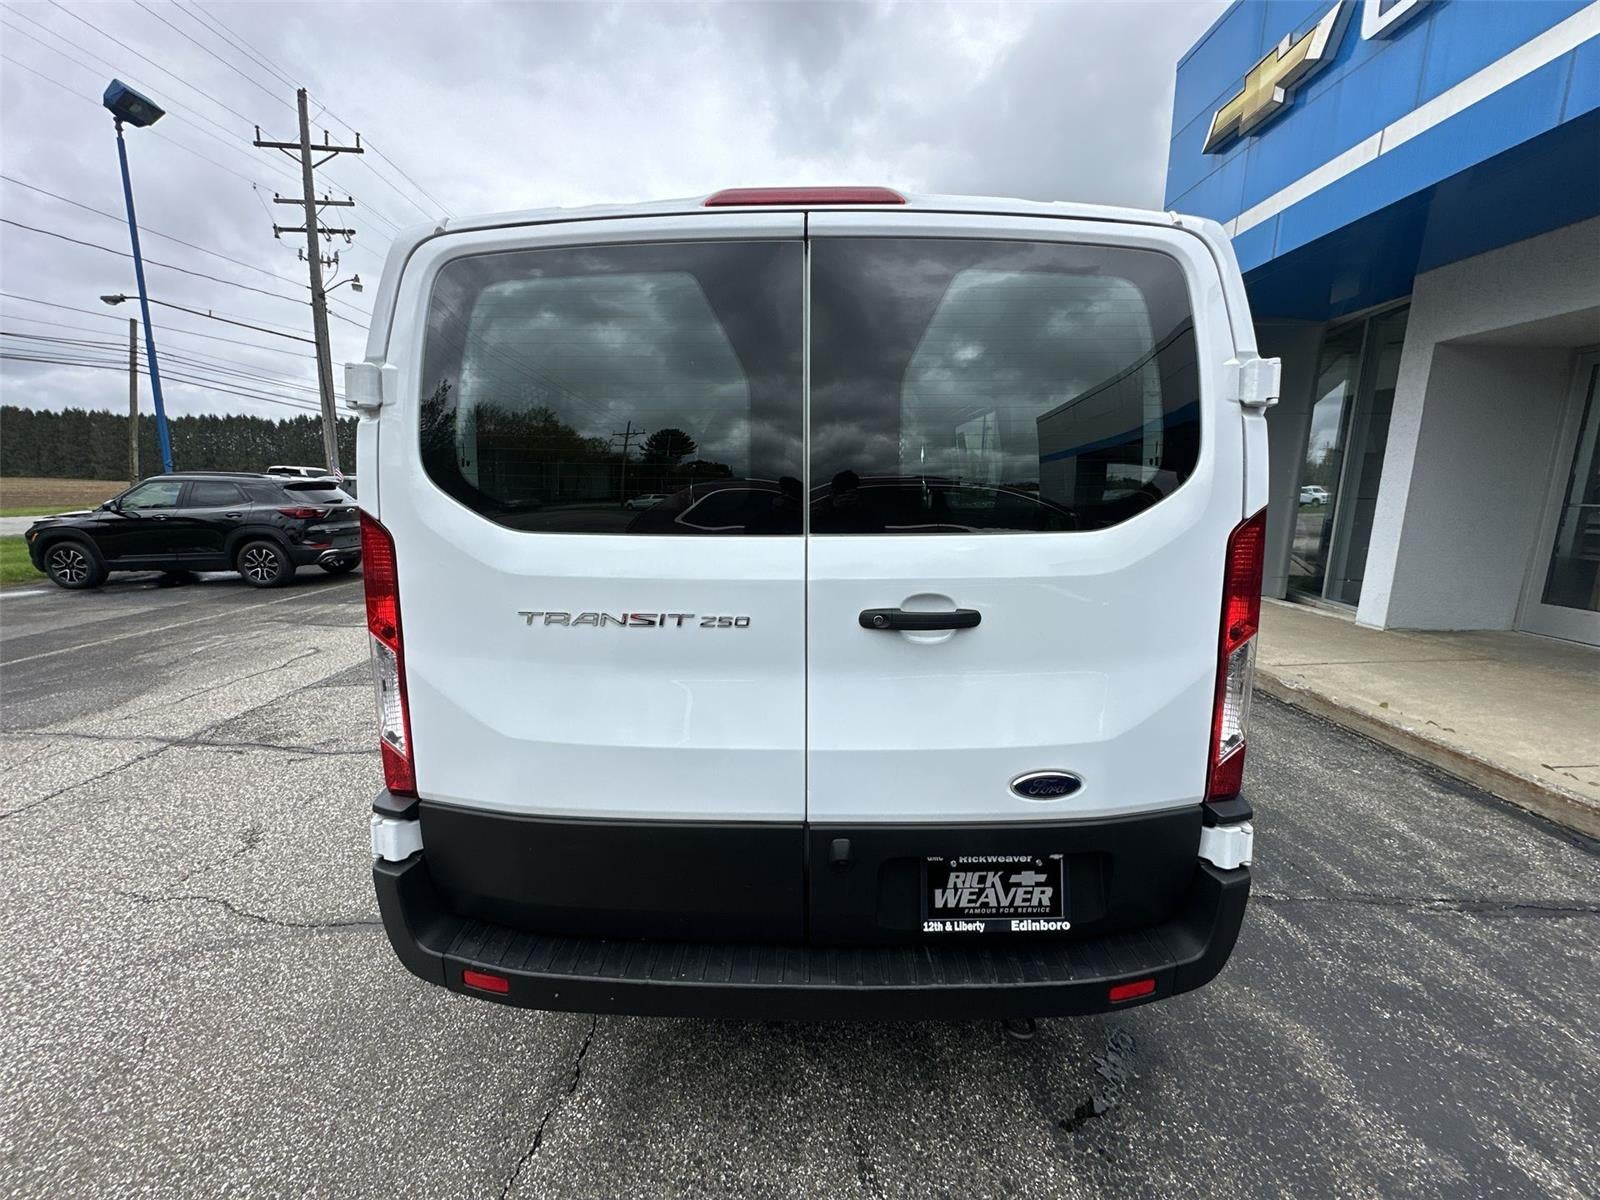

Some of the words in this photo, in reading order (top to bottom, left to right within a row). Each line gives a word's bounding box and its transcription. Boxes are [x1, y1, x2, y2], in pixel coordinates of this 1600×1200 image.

[517, 611, 695, 628] TRANSIT
[700, 616, 750, 628] 250
[1028, 778, 1067, 794] Ford
[947, 871, 1004, 889] RICK
[934, 887, 1053, 908] WEAVER
[923, 922, 943, 932] 12th
[944, 922, 953, 932] &
[954, 921, 985, 933] Liberty
[1011, 920, 1071, 931] Edinboro
